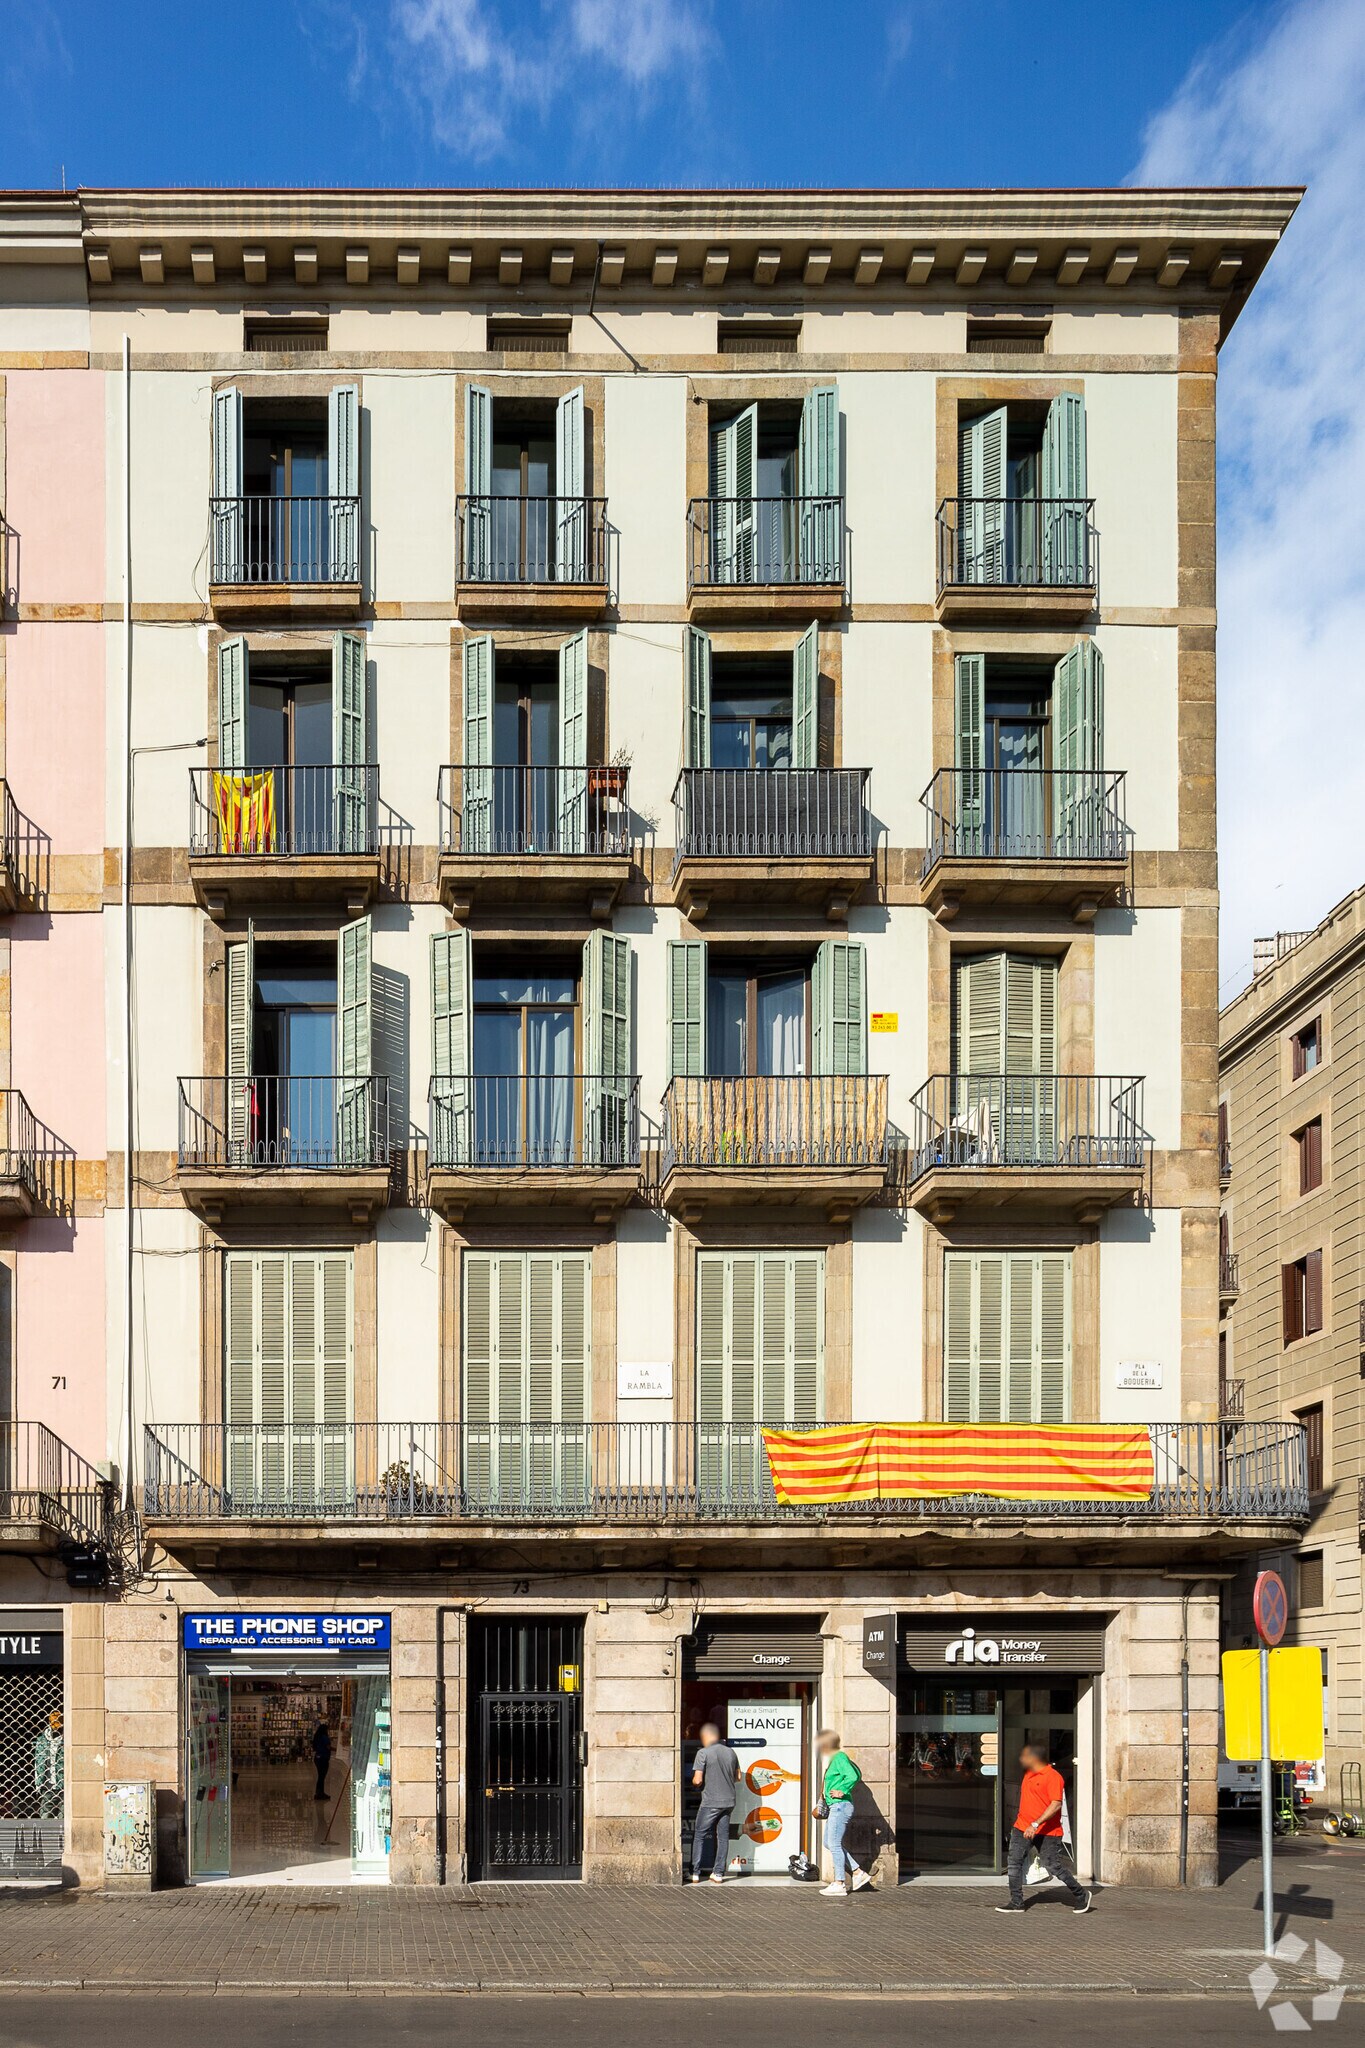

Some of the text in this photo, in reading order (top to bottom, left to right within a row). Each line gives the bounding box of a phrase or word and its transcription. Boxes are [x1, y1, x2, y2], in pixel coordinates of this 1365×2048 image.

[51, 1376, 66, 1390] 71
[627, 1382, 663, 1390] RAMBLA
[512, 1580, 530, 1595] 73
[191, 1618, 384, 1635] THE PHONE SHOP
[199, 1635, 376, 1645] REPARACIÓ ACCESSORIS SIM CARD
[868, 1630, 884, 1643] ATM
[0, 1636, 42, 1655] TYLE
[945, 1627, 1000, 1663] ria
[1001, 1639, 1041, 1652] Money
[752, 1654, 791, 1666] Change
[866, 1650, 886, 1661] Change
[1001, 1651, 1047, 1663] Transfer
[734, 1718, 795, 1730] CHANGE
[682, 1819, 696, 1831] AT
